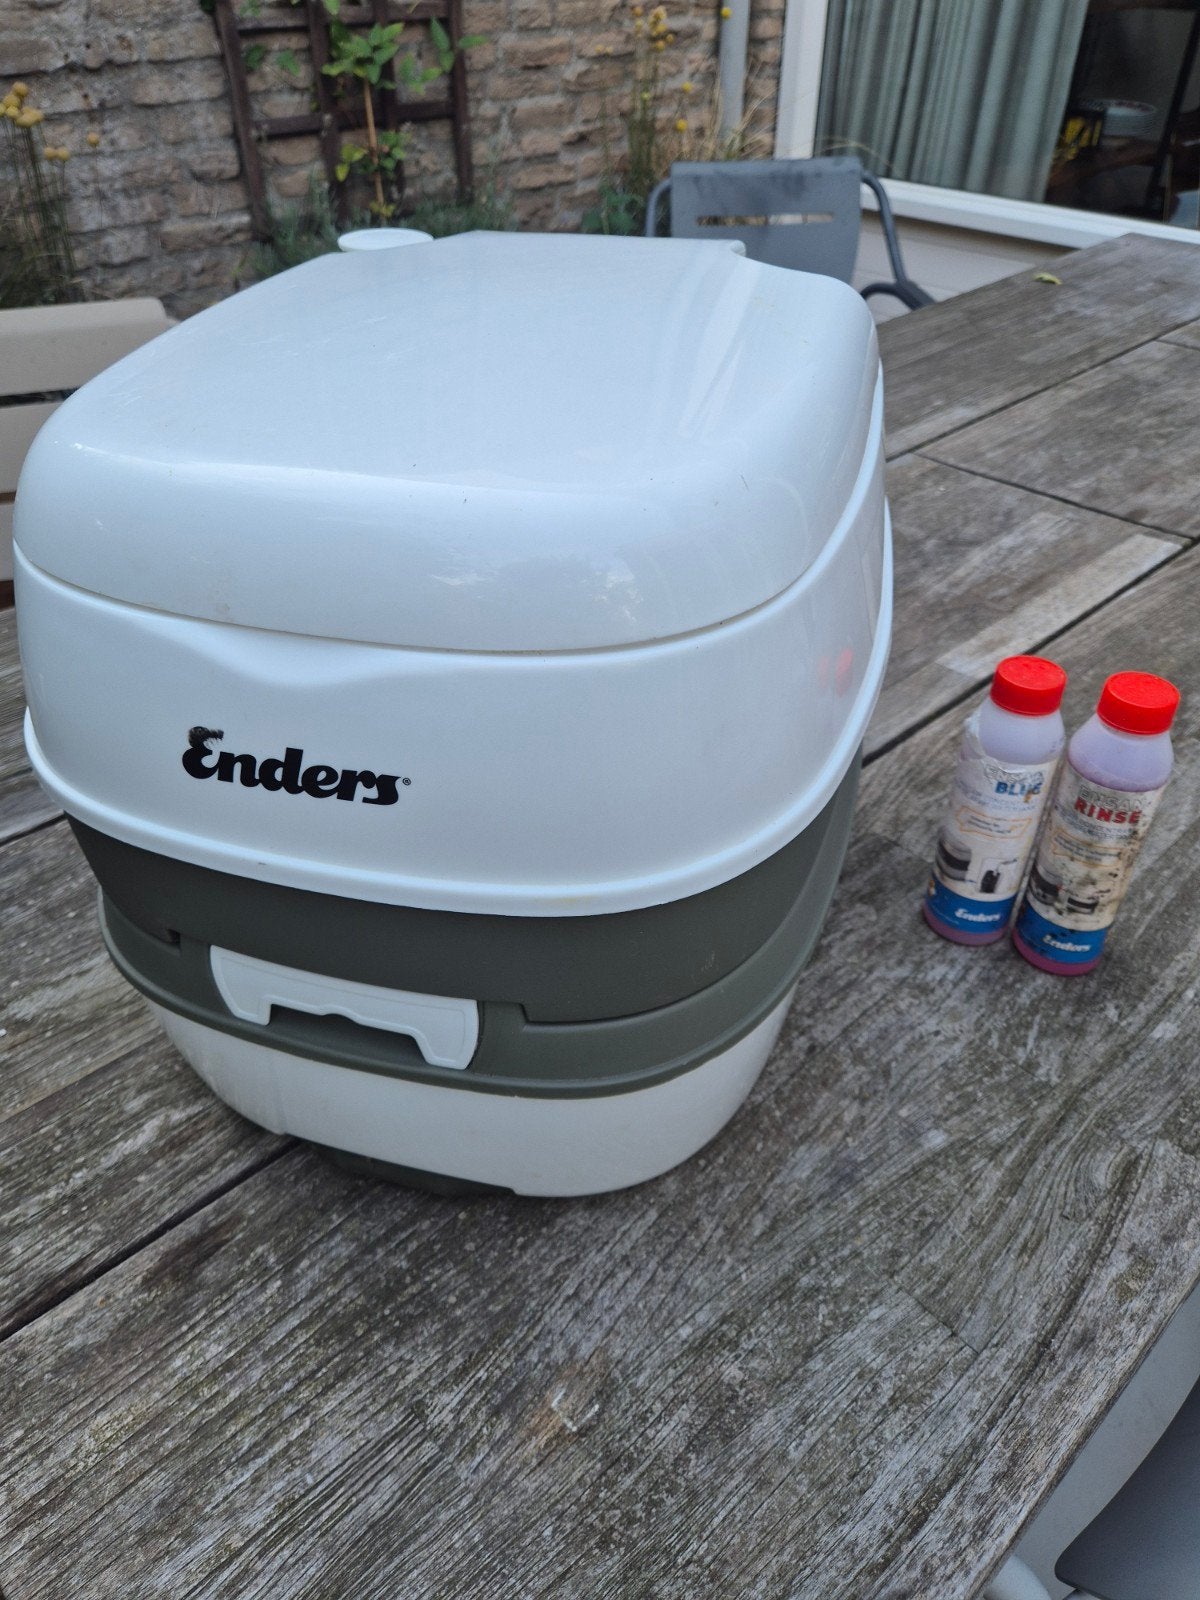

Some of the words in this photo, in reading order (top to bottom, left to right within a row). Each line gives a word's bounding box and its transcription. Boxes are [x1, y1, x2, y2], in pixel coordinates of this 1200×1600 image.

[1074, 796, 1142, 825] RINSE
[954, 908, 1001, 923] Enders
[1042, 934, 1092, 953] Enders
